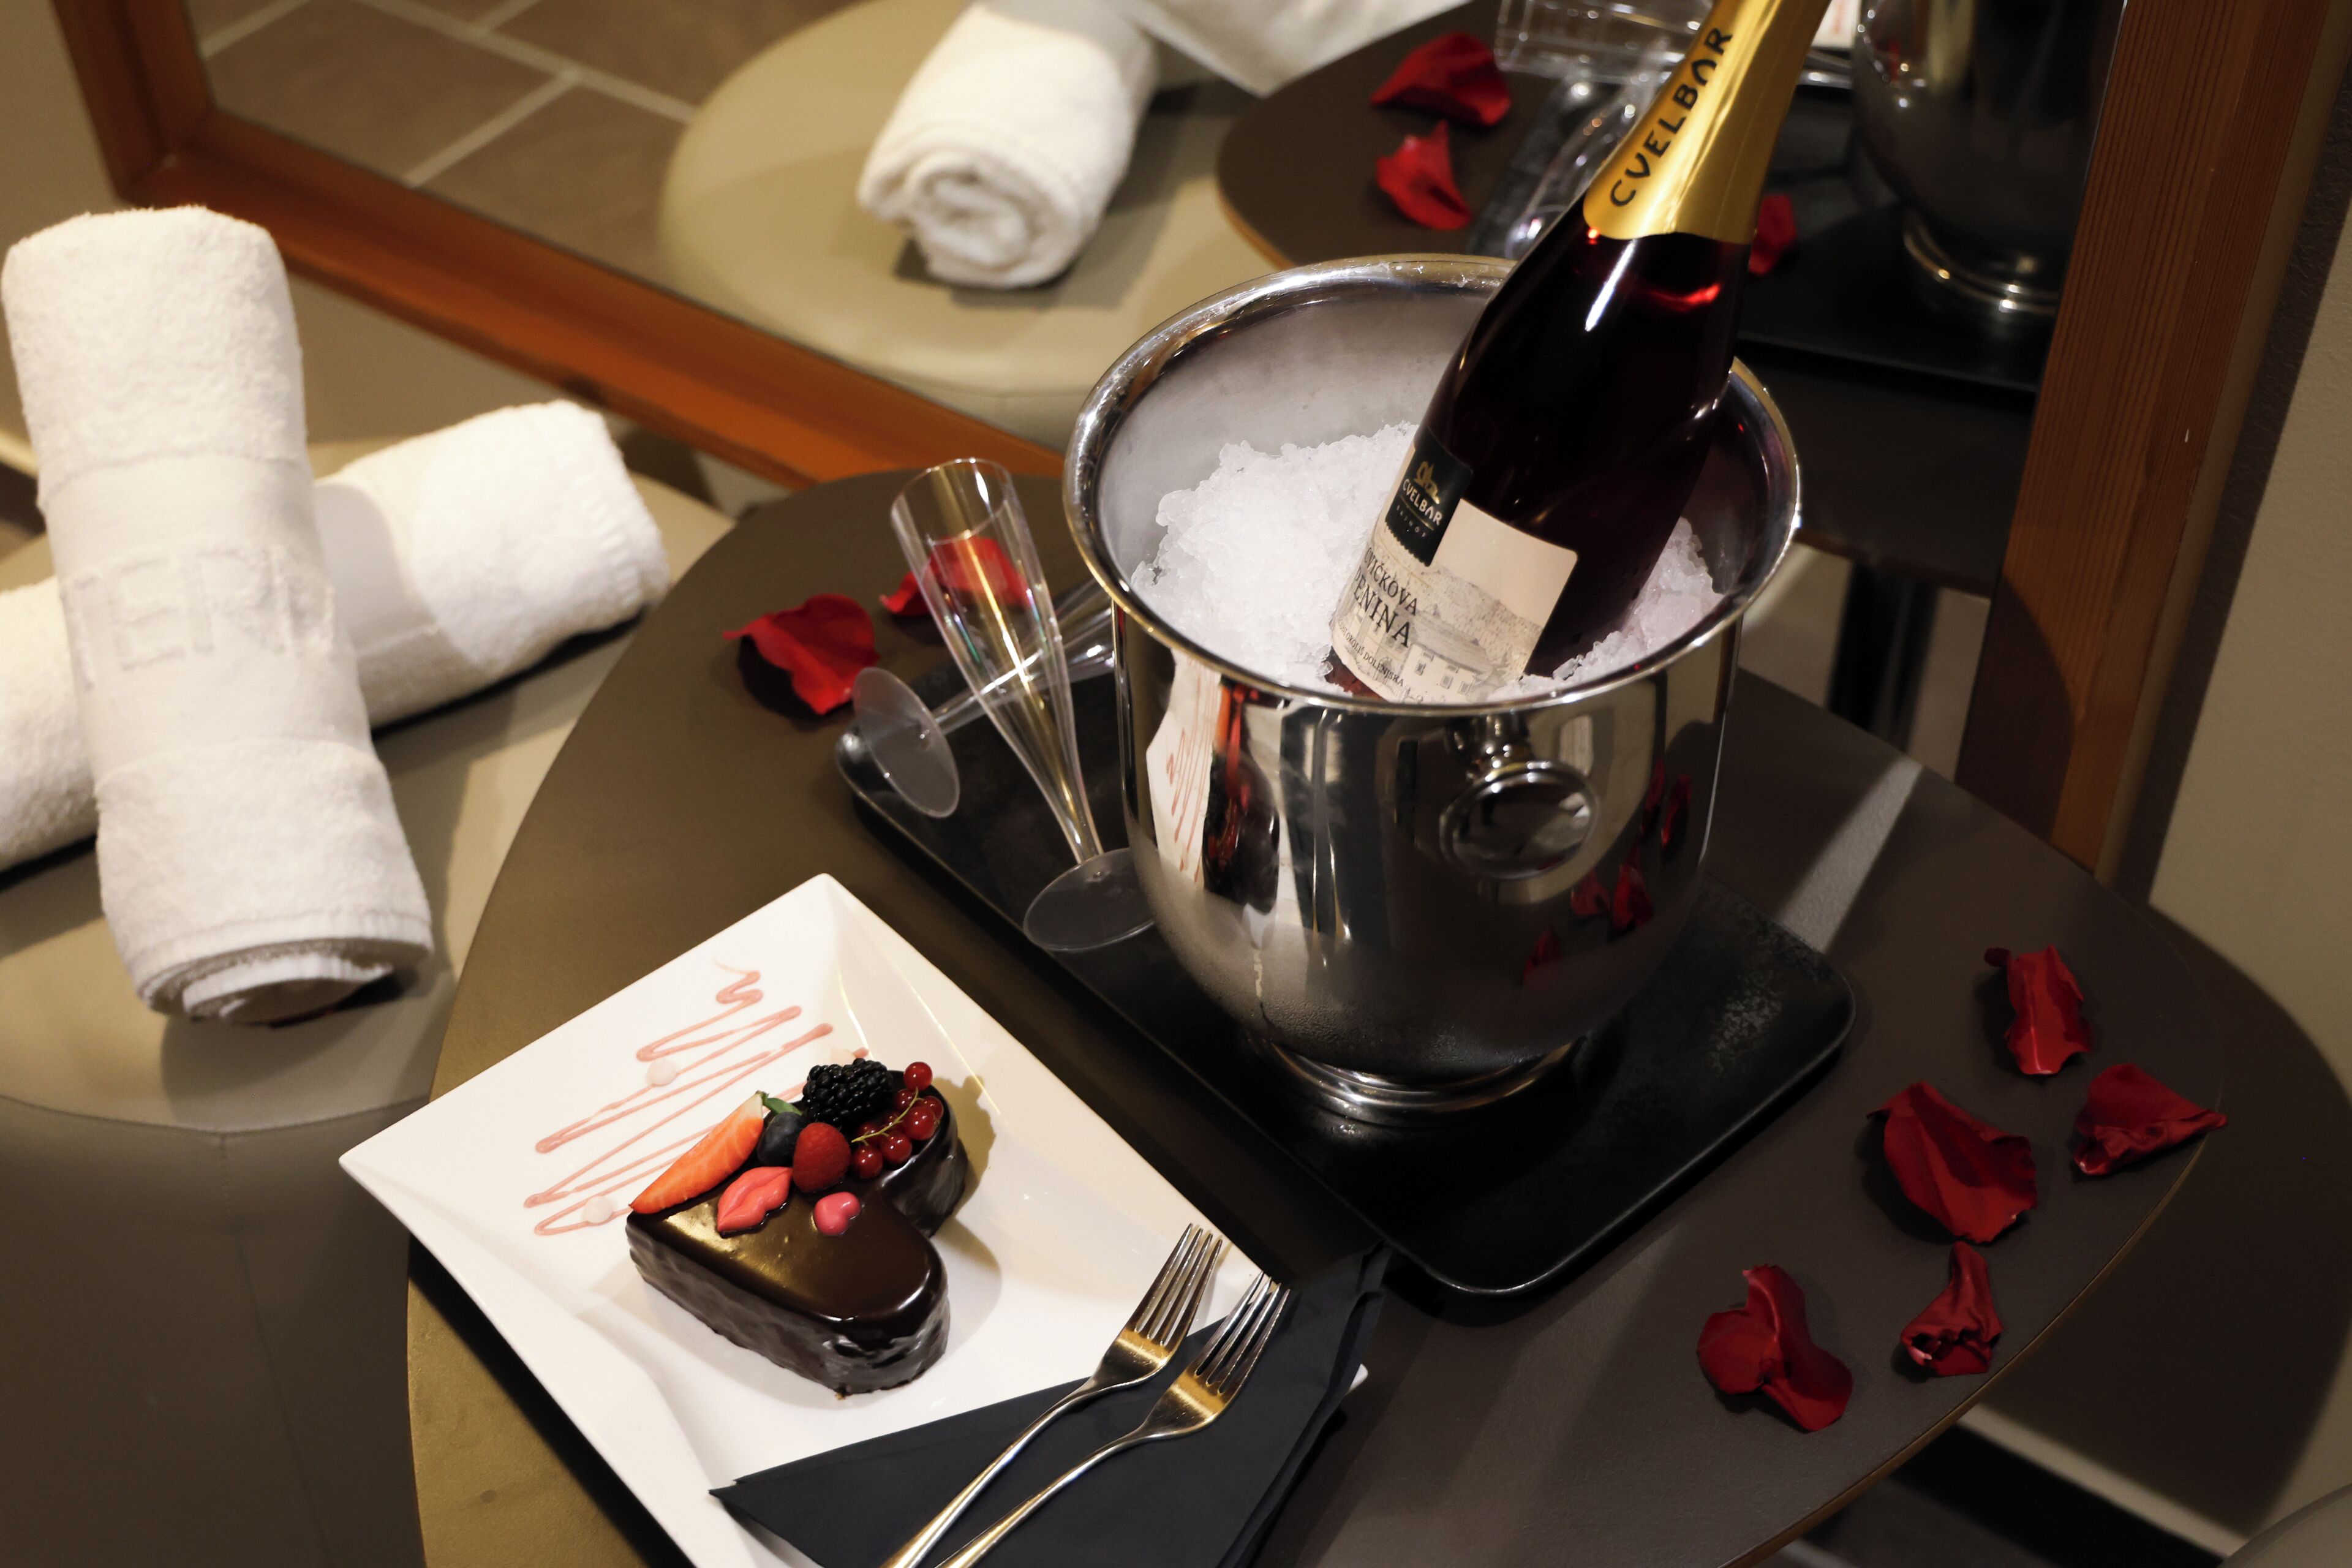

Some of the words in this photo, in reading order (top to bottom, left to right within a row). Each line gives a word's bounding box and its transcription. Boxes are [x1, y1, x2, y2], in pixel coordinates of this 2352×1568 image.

[1610, 28, 1733, 207] CVELBAR
[1403, 478, 1442, 526] CVELBAR
[1353, 565, 1411, 648] PENINA
[1364, 546, 1417, 616] CVIČKOVA
[1363, 652, 1404, 687] DOLENJSKA
